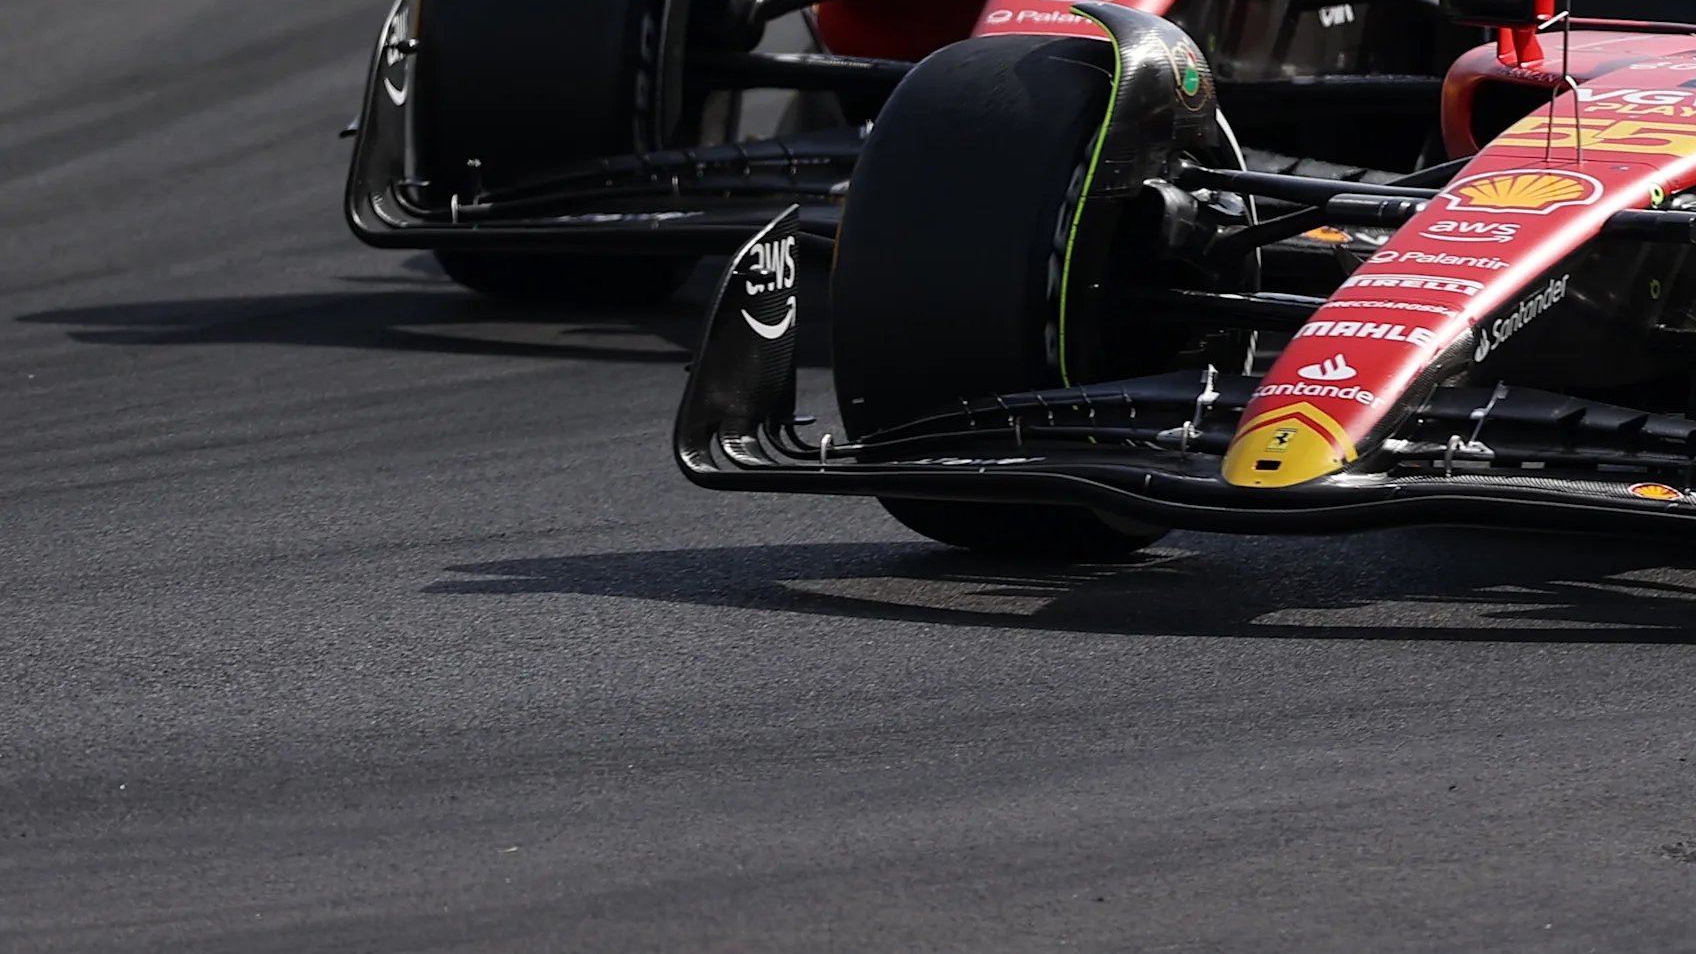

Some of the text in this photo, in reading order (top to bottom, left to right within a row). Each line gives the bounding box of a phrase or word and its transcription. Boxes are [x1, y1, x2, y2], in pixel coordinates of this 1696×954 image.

[1017, 8, 1095, 24] Palan
[1427, 219, 1522, 236] aws
[746, 235, 796, 296] aws
[1398, 250, 1512, 271] Palantir
[1339, 273, 1486, 297] PIRELLI
[1490, 274, 1570, 351] Santander
[1294, 320, 1440, 348] MAHLE
